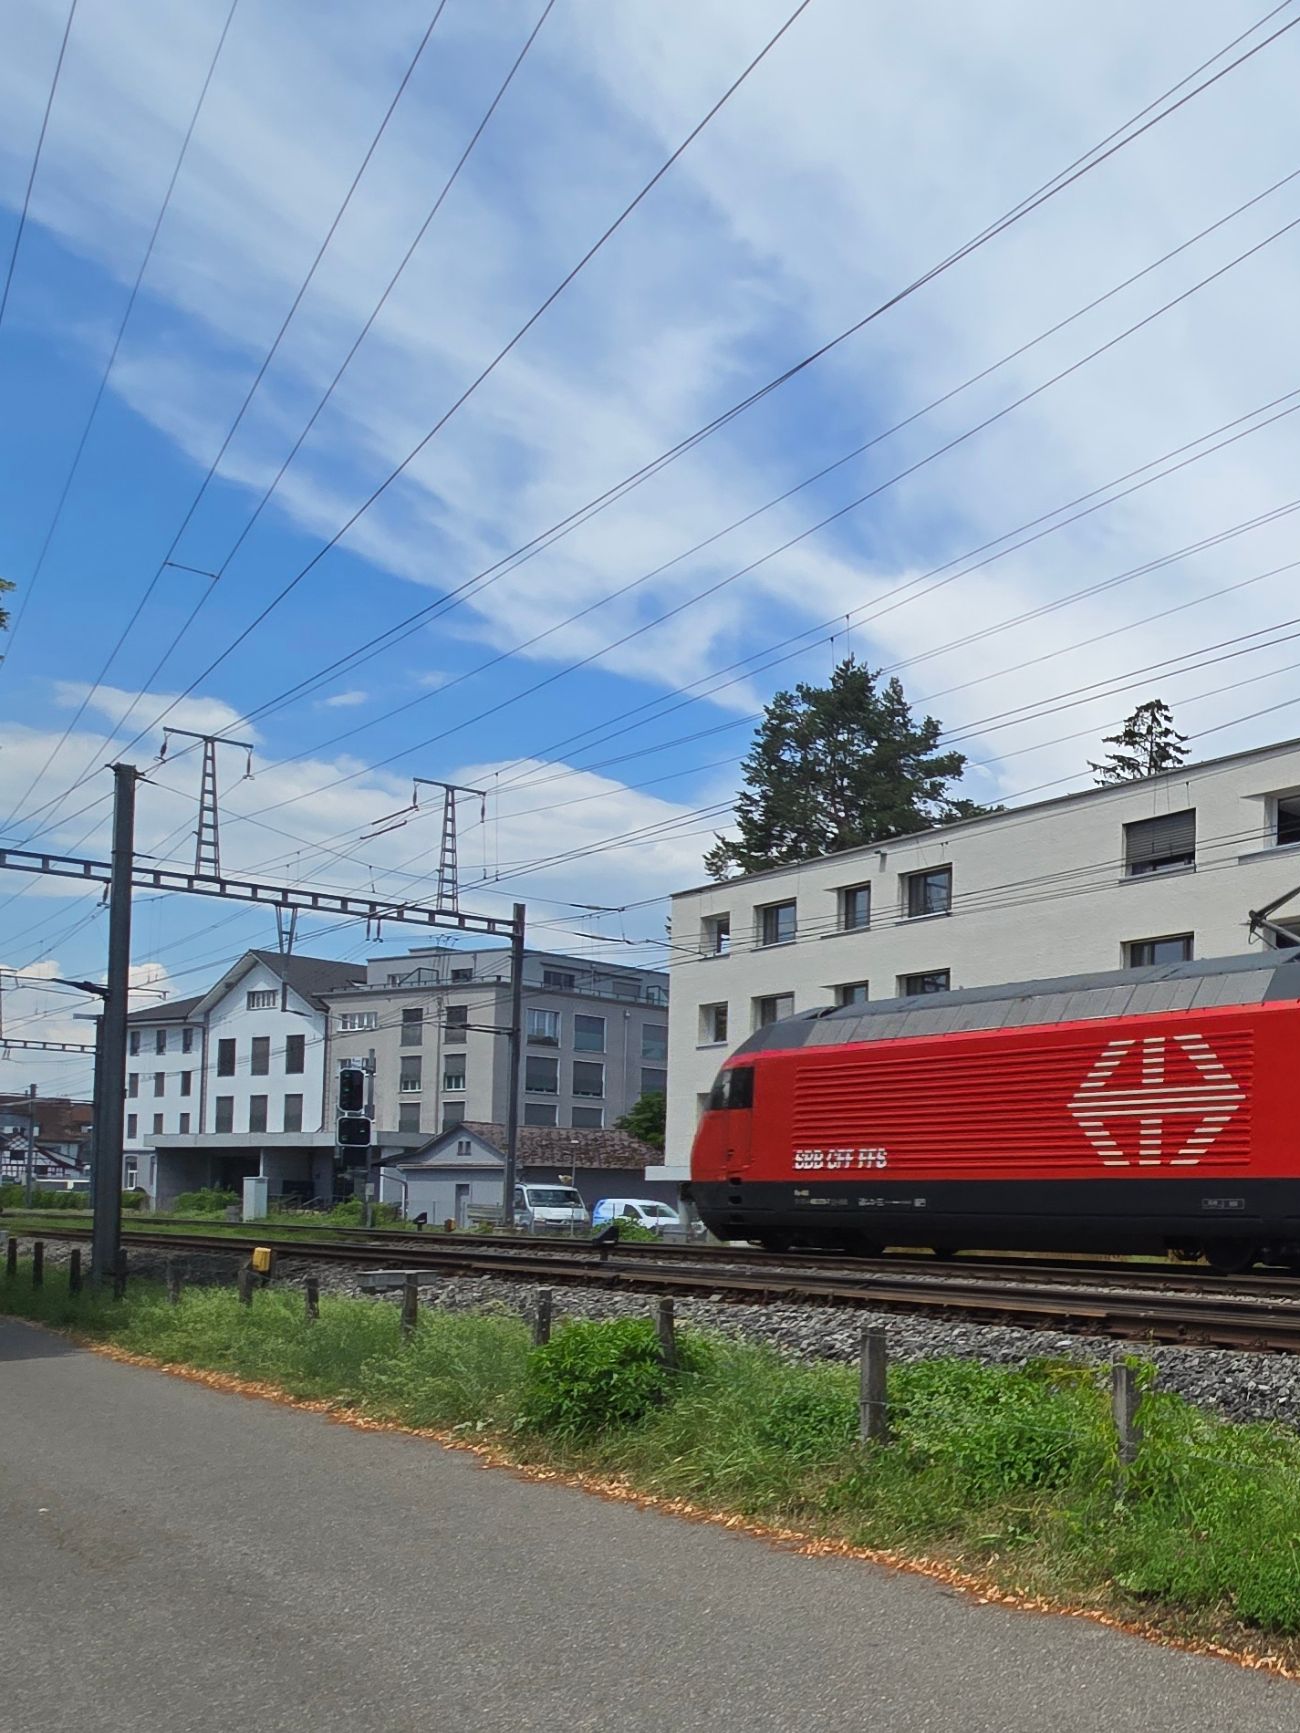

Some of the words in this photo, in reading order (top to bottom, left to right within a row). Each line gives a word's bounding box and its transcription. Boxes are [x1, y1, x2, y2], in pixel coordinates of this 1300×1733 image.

[794, 1149, 824, 1170] SBB
[826, 1148, 855, 1170] CFF
[857, 1147, 888, 1169] FFS
